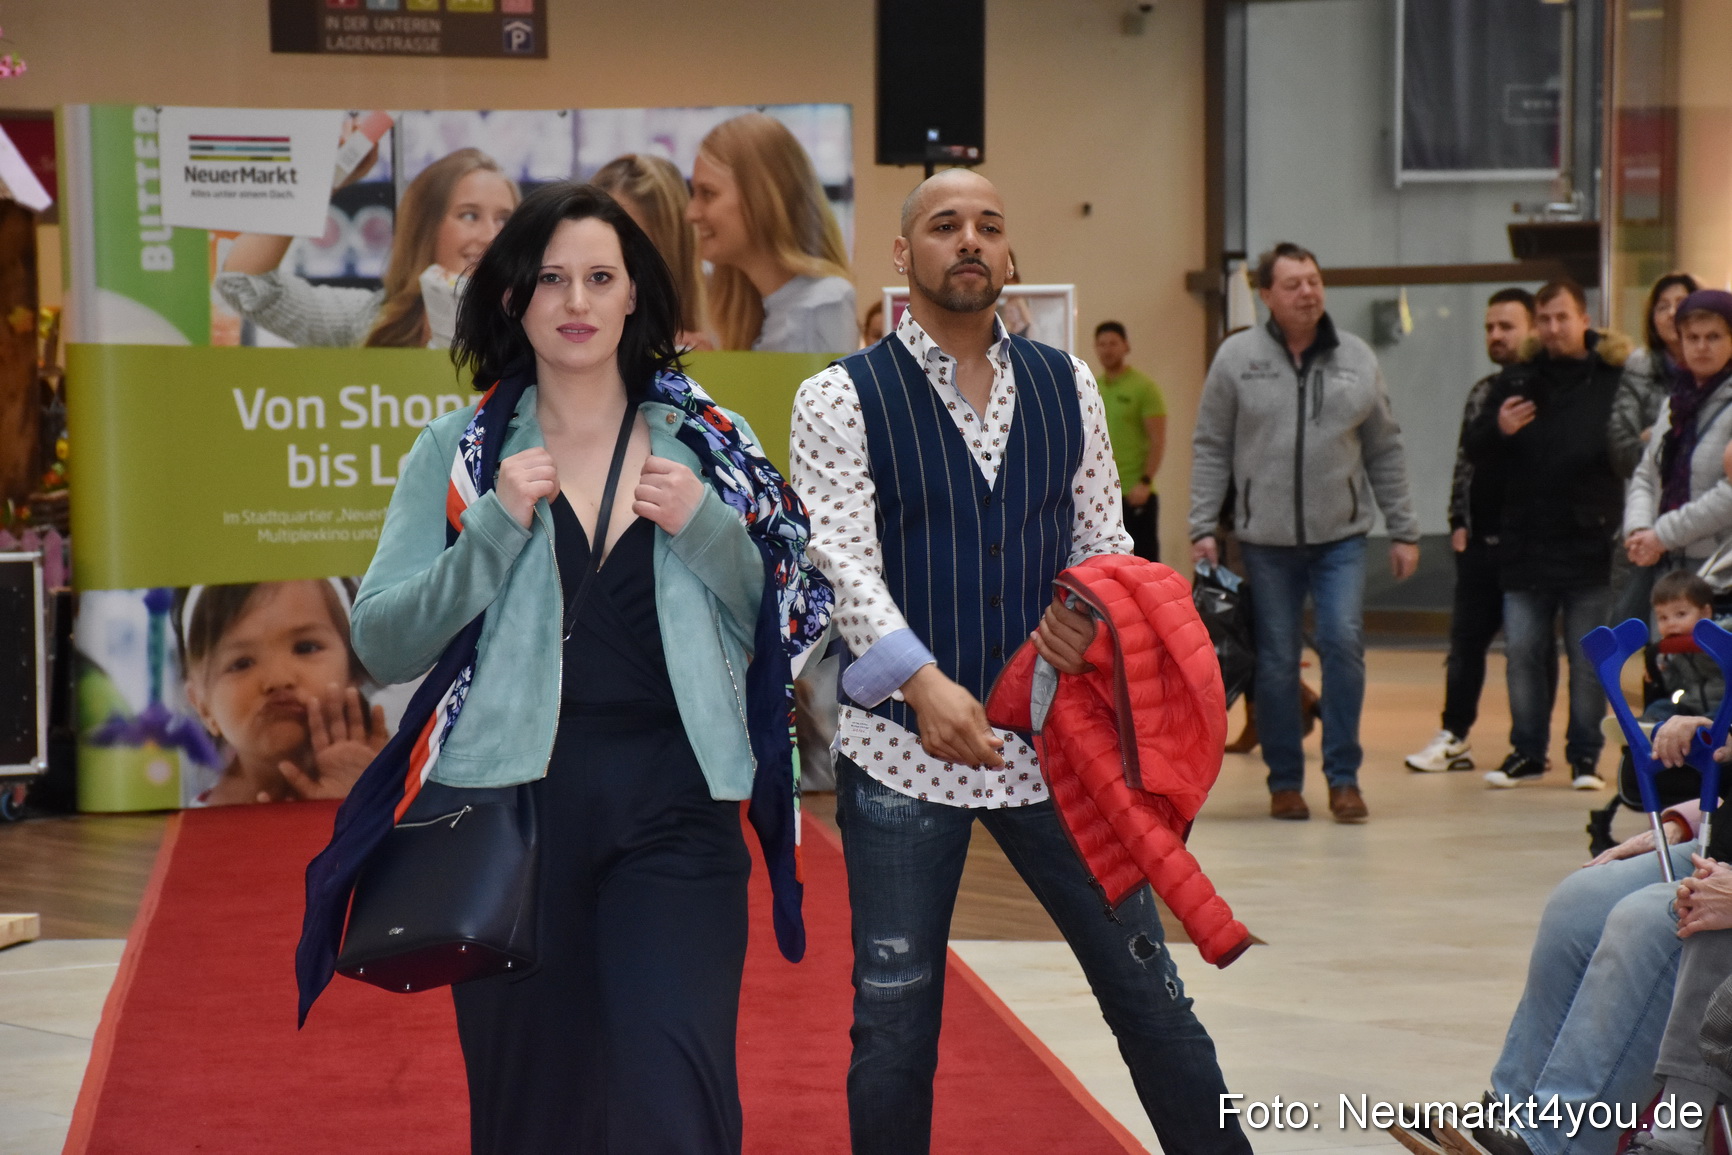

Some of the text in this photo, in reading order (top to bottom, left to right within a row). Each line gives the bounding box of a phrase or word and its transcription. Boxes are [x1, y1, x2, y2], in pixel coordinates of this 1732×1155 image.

[324, 15, 441, 33] IN DER UNTEREN
[325, 35, 440, 52] LADENSTRASSE
[511, 29, 526, 50] P
[184, 165, 298, 185] NeuerMarkt
[191, 189, 211, 199] Alles
[213, 190, 237, 199] unter
[239, 190, 268, 199] einem
[232, 384, 482, 430] Von Shop
[287, 443, 359, 488] bis
[223, 511, 240, 525] Im
[241, 509, 332, 526] Stadtquartier
[257, 526, 379, 544] Multiplexkino und
